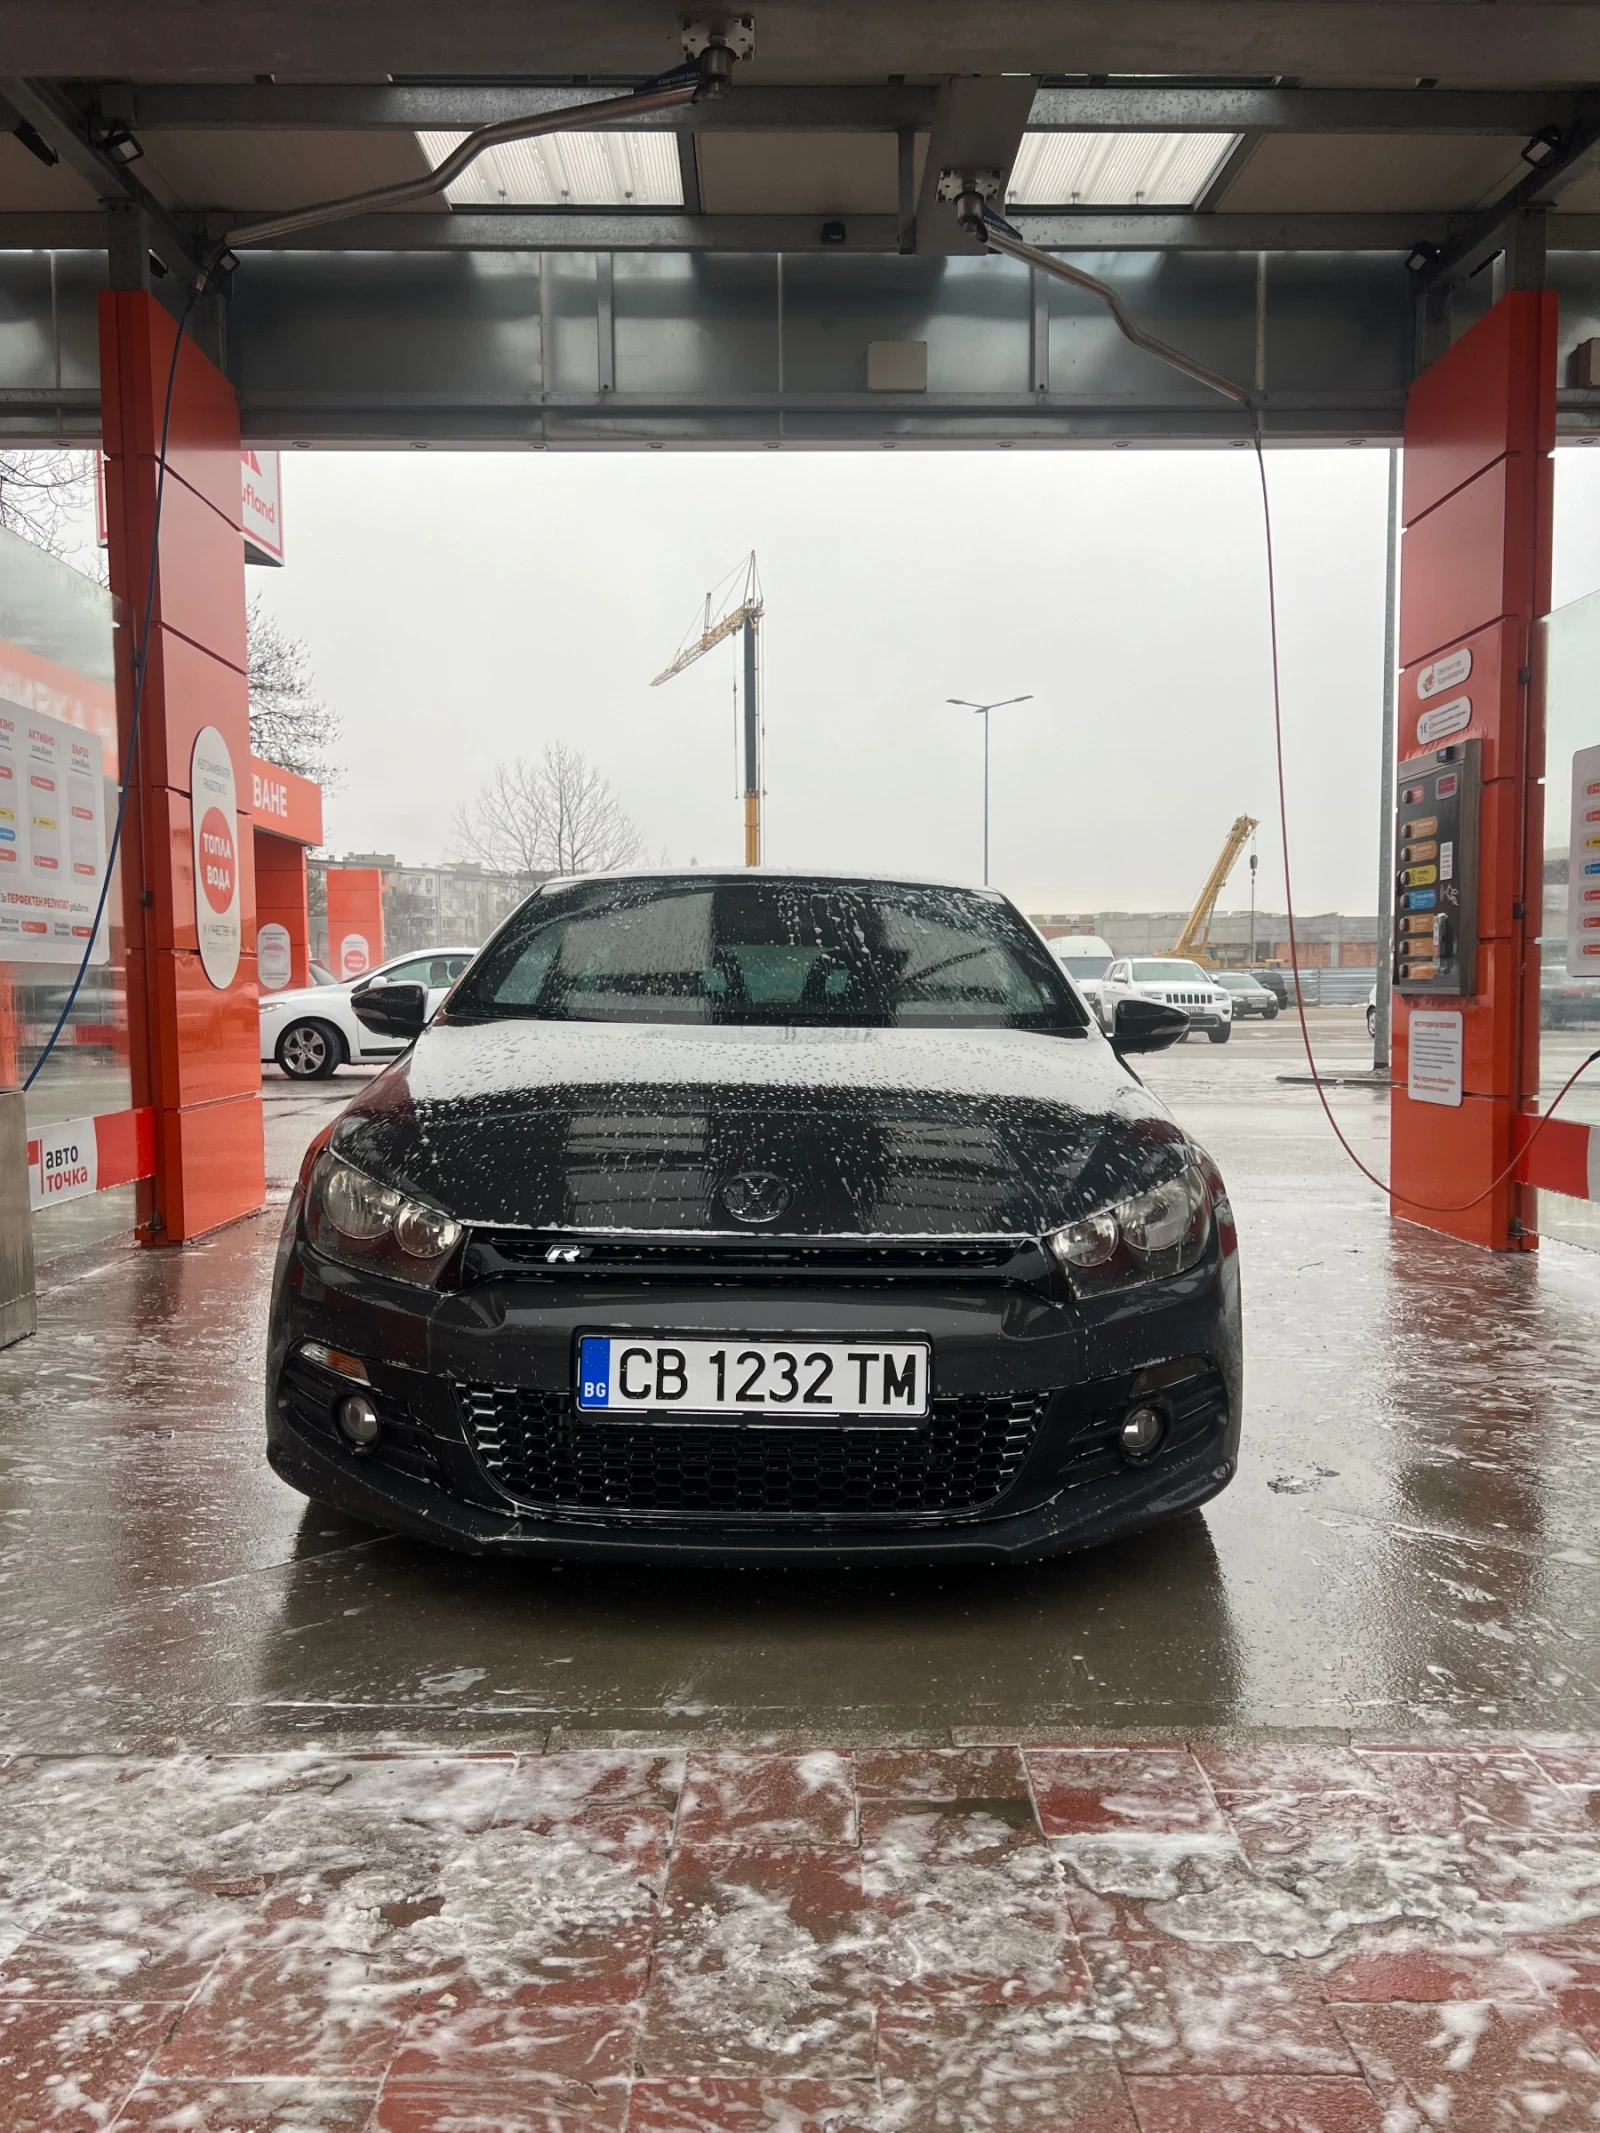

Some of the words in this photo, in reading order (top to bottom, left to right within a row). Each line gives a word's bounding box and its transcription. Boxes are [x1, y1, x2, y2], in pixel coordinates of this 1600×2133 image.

[28, 728, 55, 747] АКТИВНО
[203, 833, 232, 859] ТОПЛА
[207, 865, 231, 891] ВОДА
[7, 892, 43, 907] ПЕРФЕКТЕН
[46, 1145, 78, 1169] авто
[46, 1166, 88, 1192] точка
[584, 1381, 607, 1398] BG
[619, 1347, 688, 1401] CB
[709, 1350, 833, 1403] 1232
[847, 1352, 916, 1406] TM
